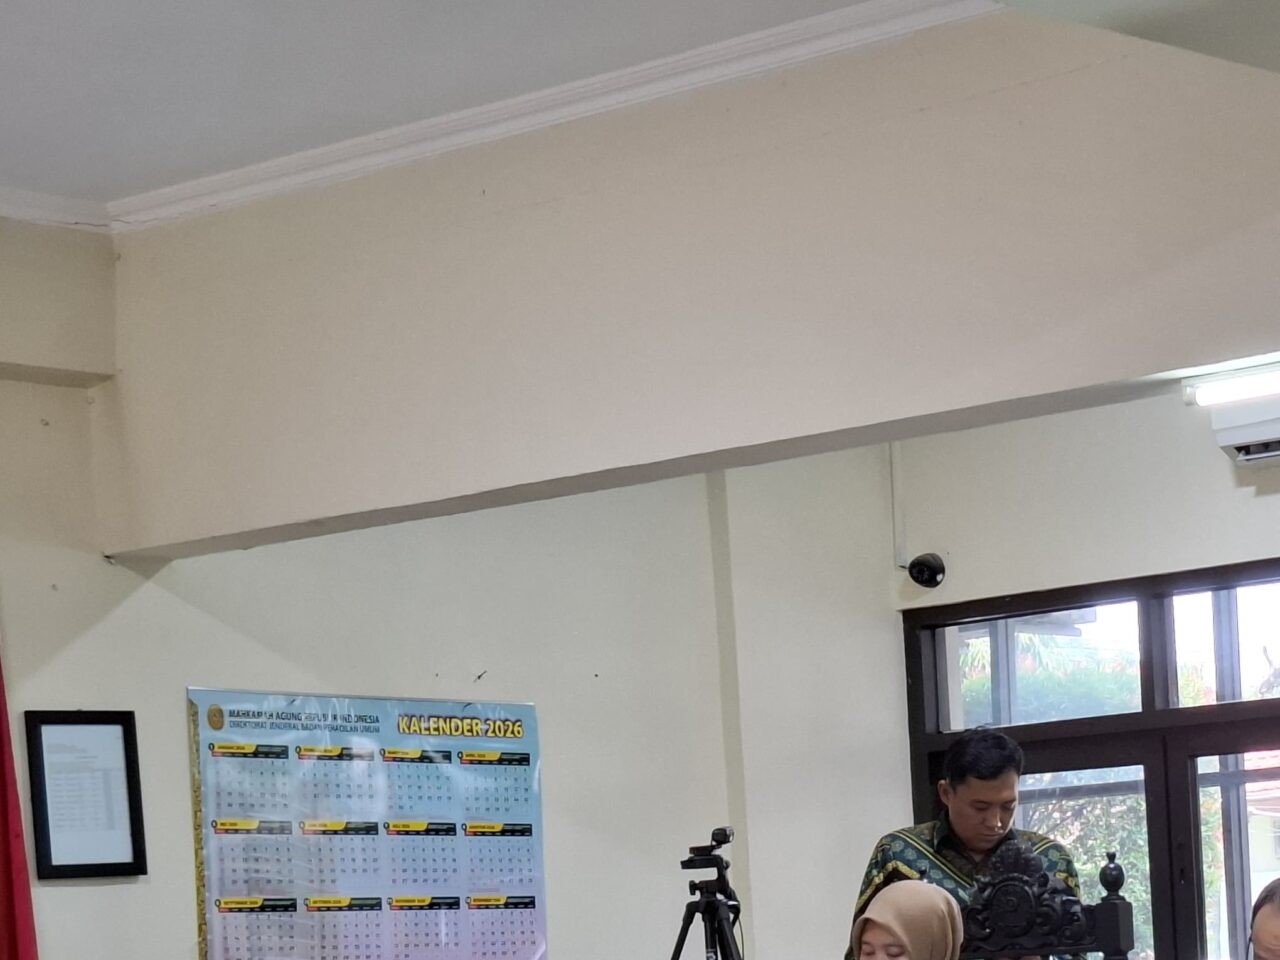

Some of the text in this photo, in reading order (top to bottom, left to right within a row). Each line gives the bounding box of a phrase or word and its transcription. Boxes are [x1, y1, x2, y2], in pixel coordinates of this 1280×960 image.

[276, 710, 302, 721] AGUNG
[398, 715, 524, 738] KALENDER 2026
